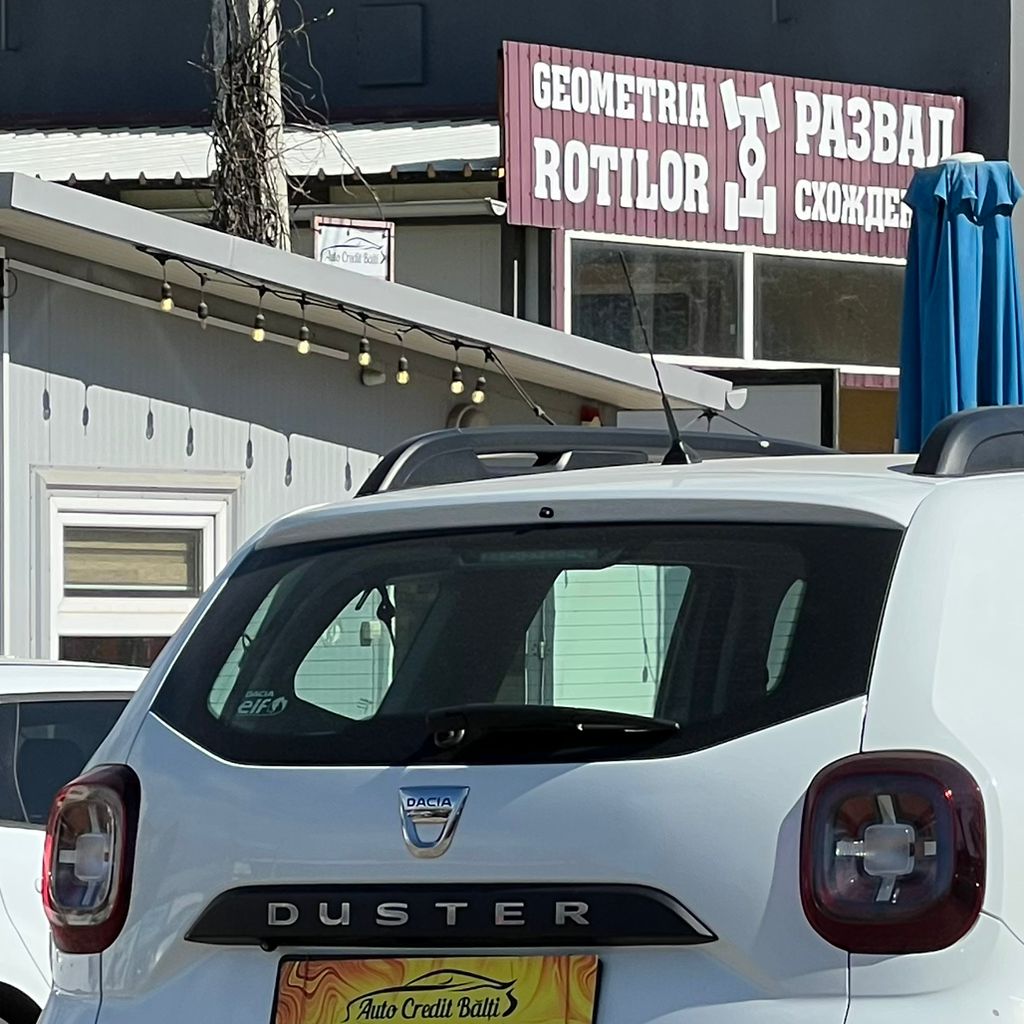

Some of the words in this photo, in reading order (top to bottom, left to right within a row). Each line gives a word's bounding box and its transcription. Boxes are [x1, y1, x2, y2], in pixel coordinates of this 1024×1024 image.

[533, 61, 710, 128] GEOMETRIA
[795, 90, 955, 168] РАЗВАЛ
[533, 137, 710, 214] ROTILOR
[238, 699, 271, 714] elf
[407, 797, 452, 807] DACIA
[268, 902, 590, 926] DUSTER
[357, 998, 398, 1020] Auto
[402, 997, 453, 1019] Credit
